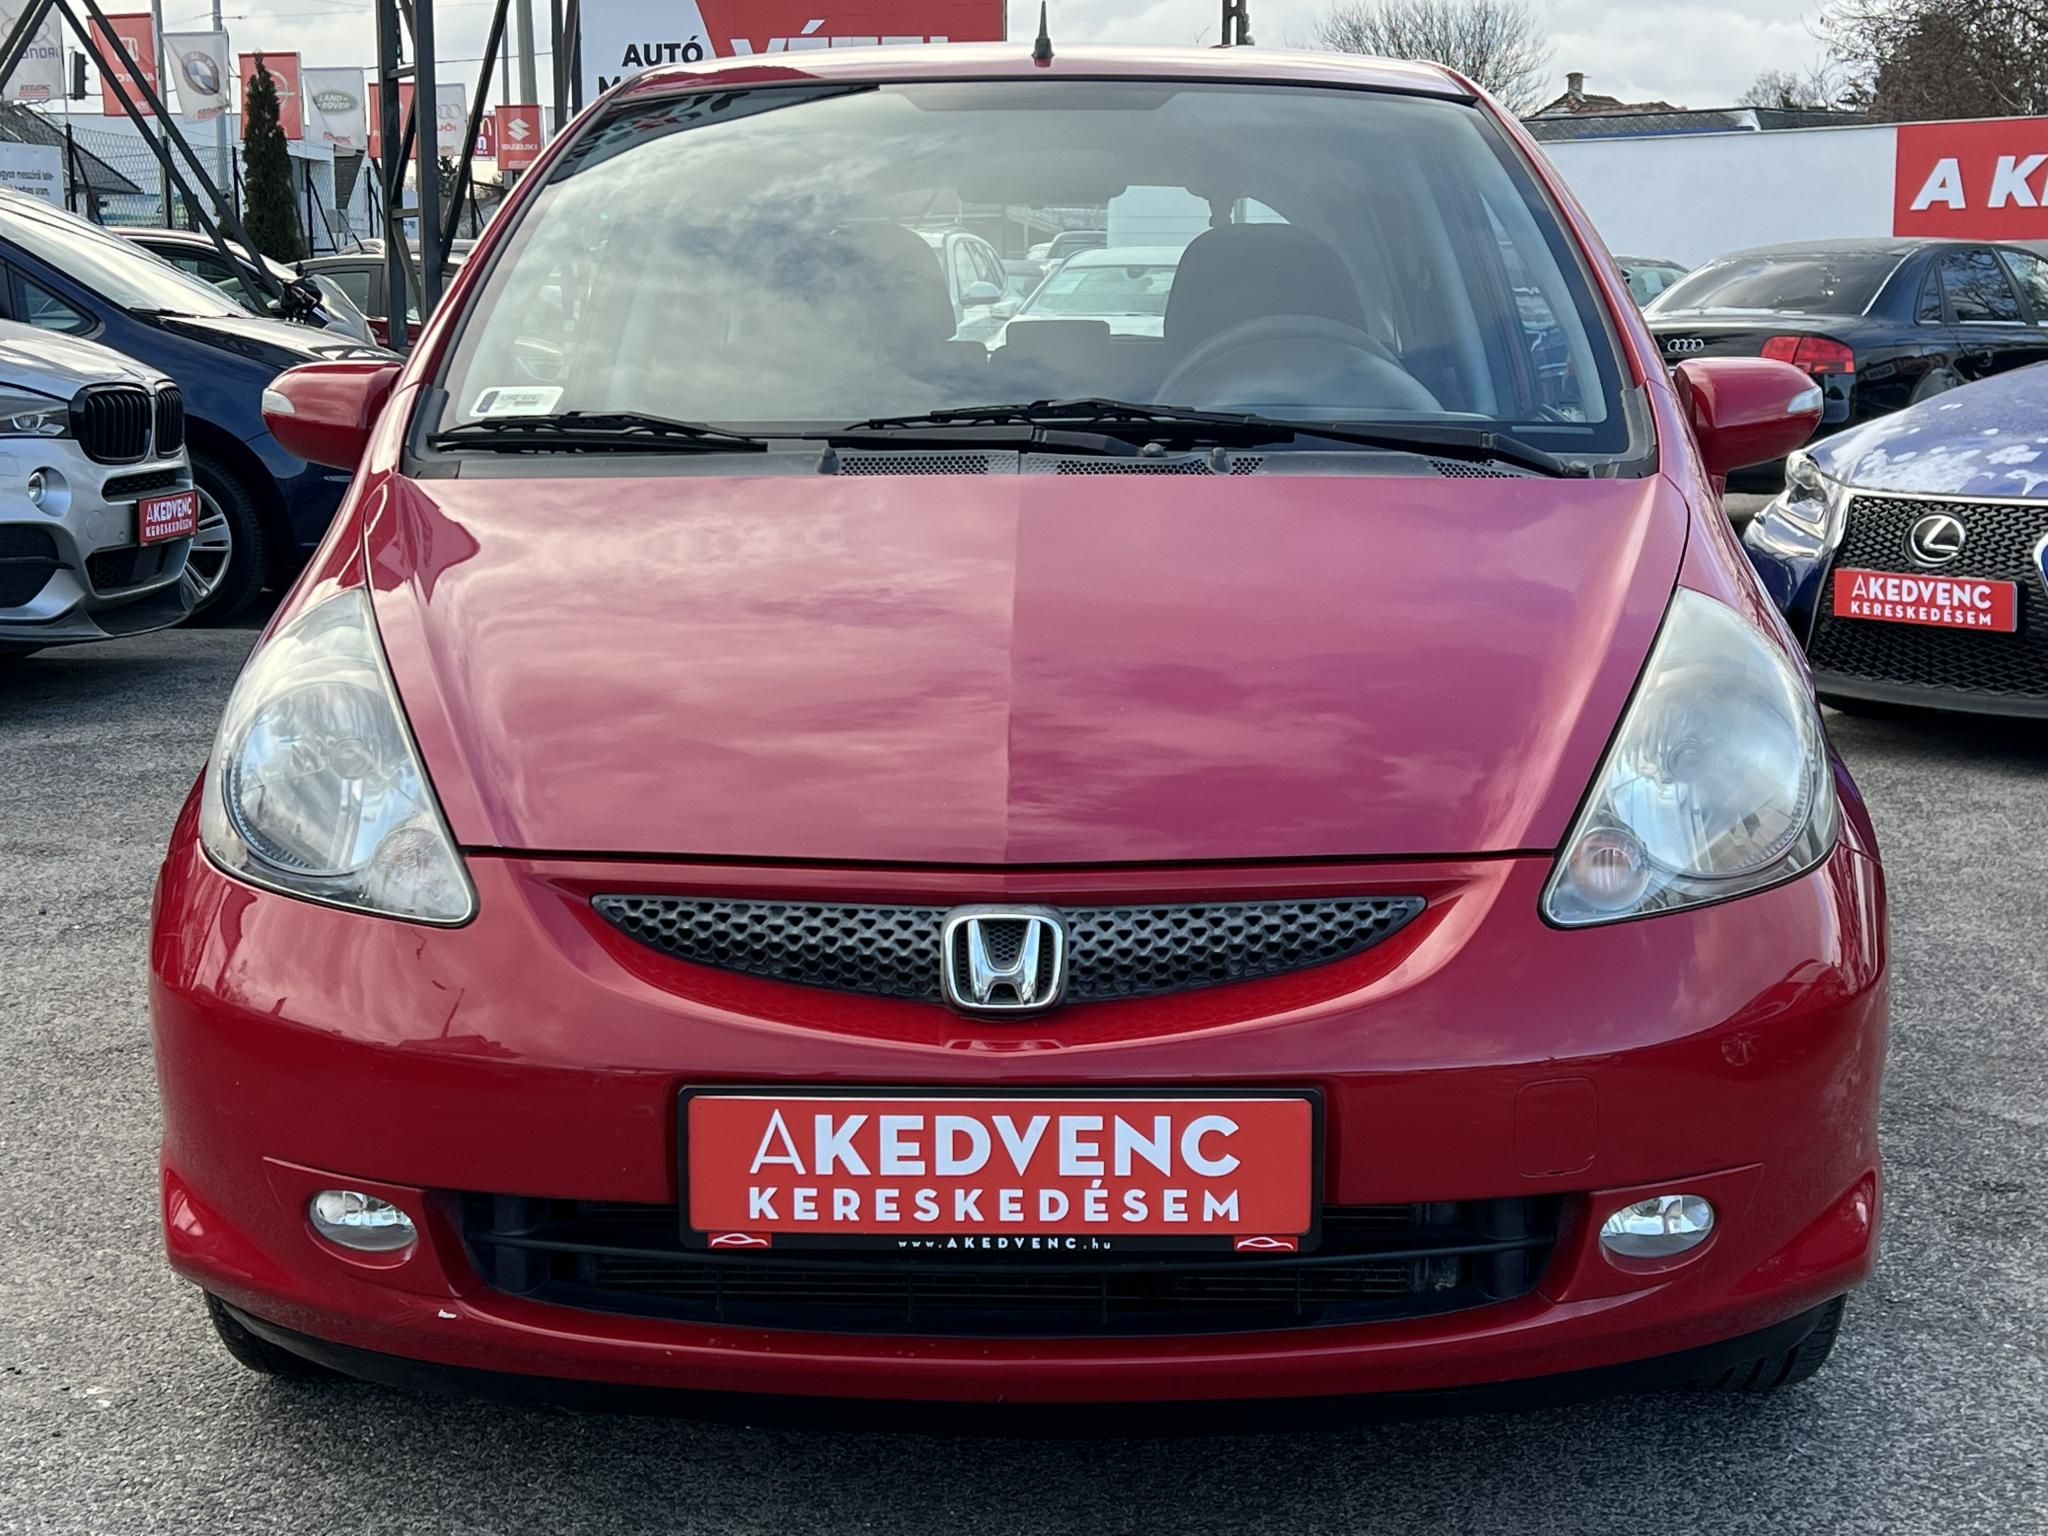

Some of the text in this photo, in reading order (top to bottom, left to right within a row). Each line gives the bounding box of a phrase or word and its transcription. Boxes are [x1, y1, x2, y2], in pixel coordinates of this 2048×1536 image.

[622, 35, 703, 67] AUTÓ
[1910, 154, 2048, 211] A K
[1852, 575, 1992, 609] AKEDVENC
[1851, 601, 1992, 626] KERESKEDÉSEM
[749, 1108, 1240, 1177] AKEDVENC
[749, 1180, 1240, 1222] KERESKEDÉSEM
[898, 1236, 1111, 1250] www.AKEDVENC.hu
